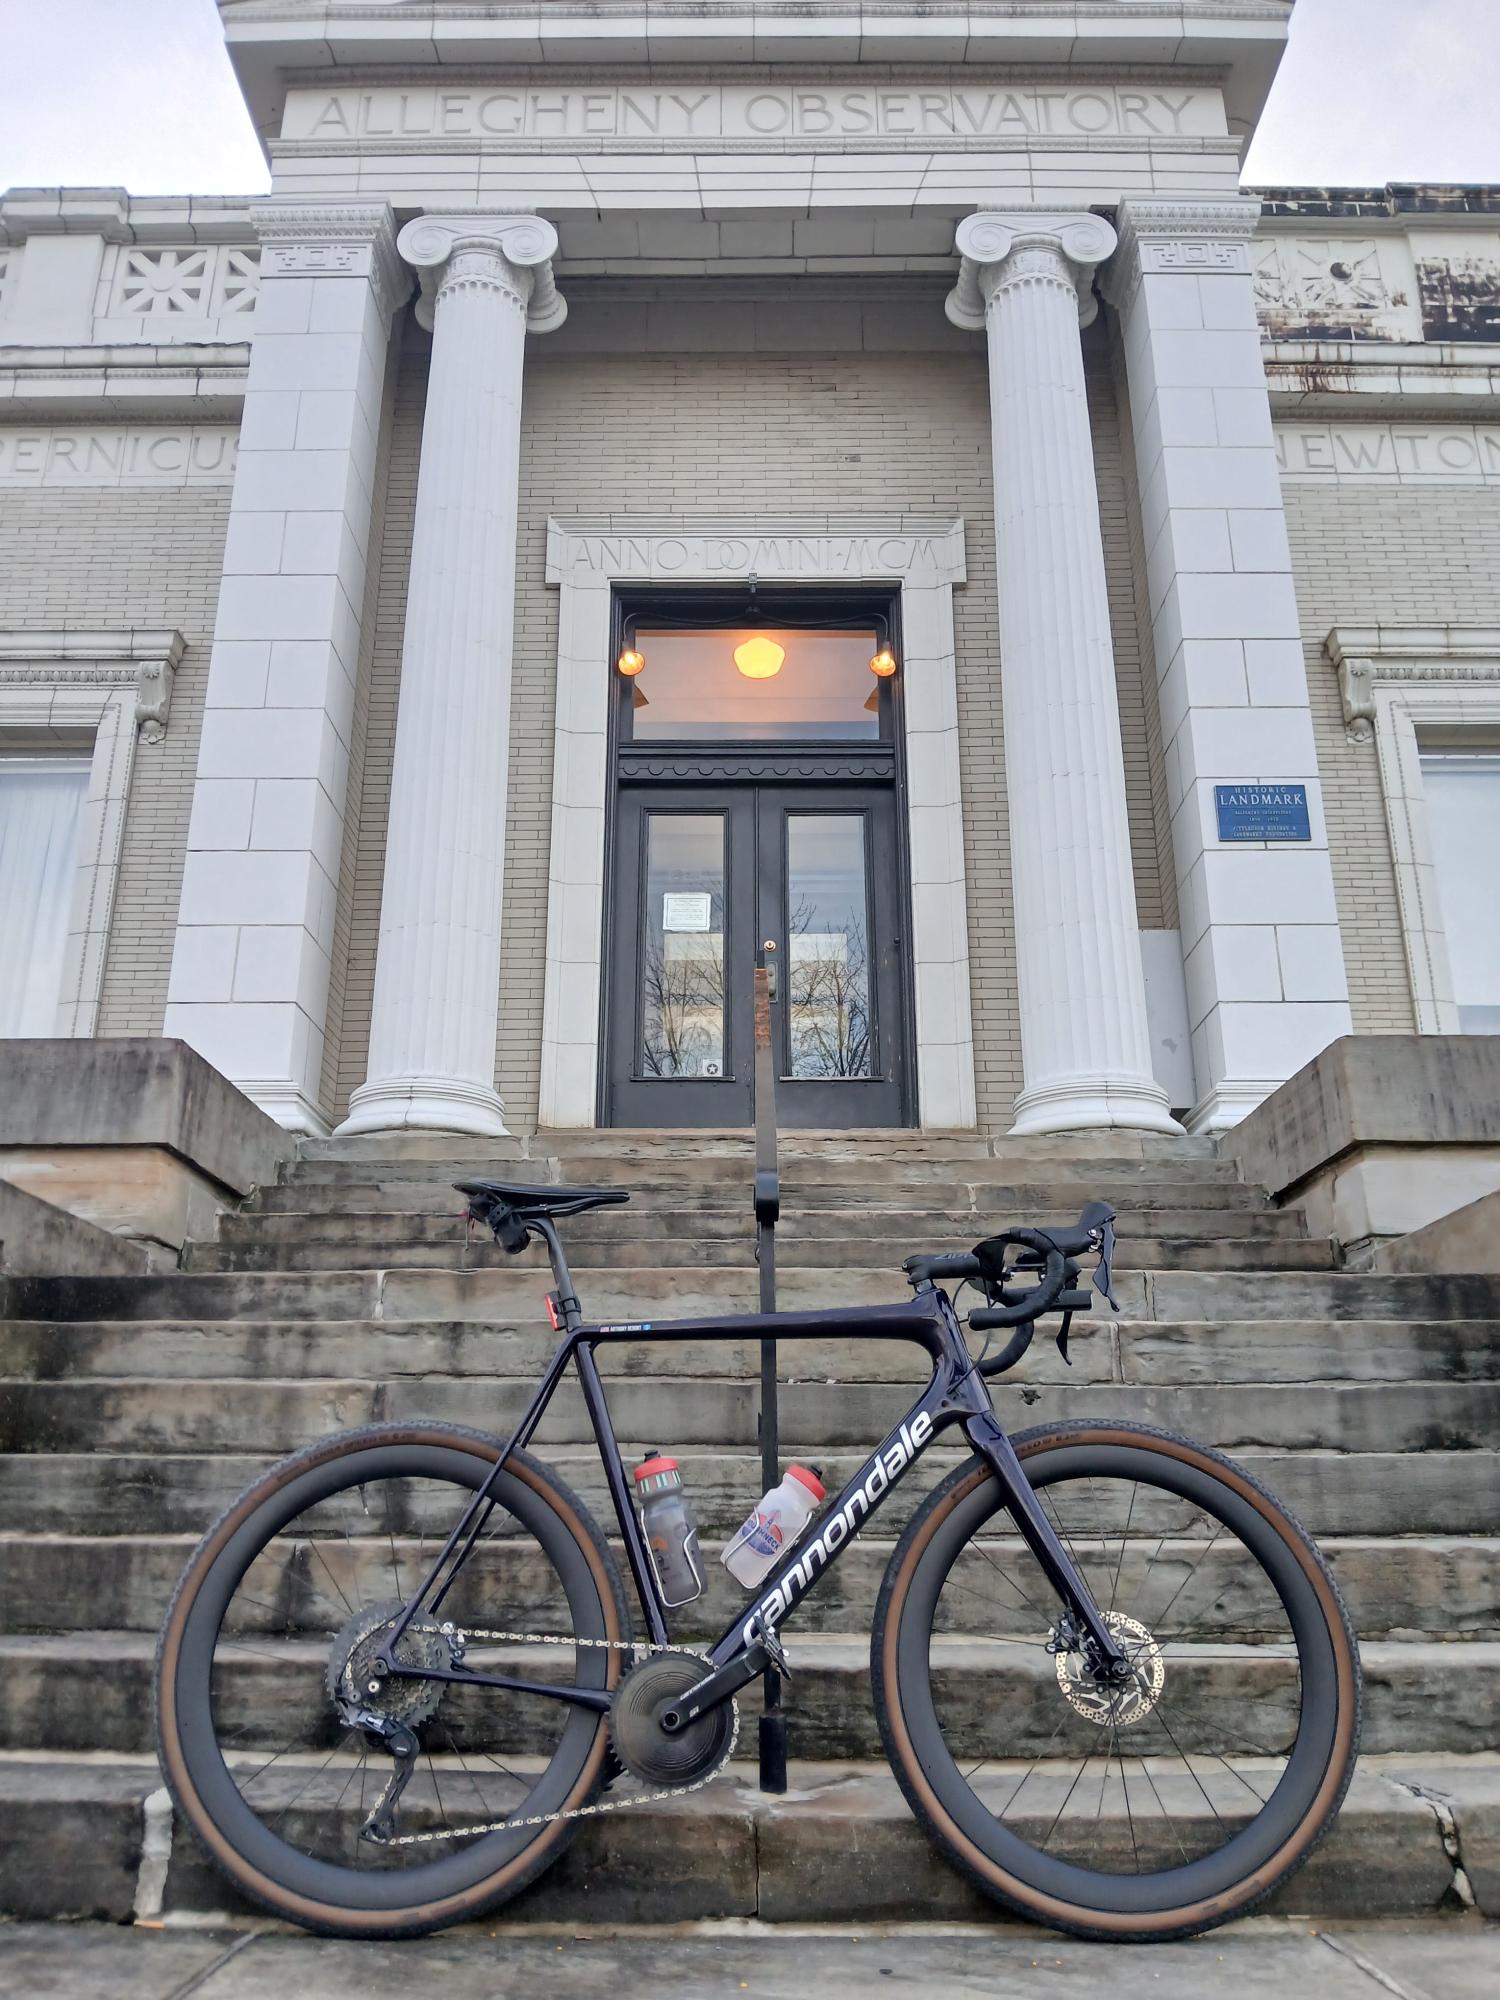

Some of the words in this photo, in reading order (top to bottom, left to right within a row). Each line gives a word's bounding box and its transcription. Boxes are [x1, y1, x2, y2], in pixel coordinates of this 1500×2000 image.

[308, 94, 711, 136] ALLEGHENY
[744, 93, 1195, 134] OBSERVATORY
[0, 436, 239, 473] ERNICU
[572, 538, 688, 570] ANNO
[702, 539, 833, 570] DOMINI
[842, 538, 939, 571] MCM
[1220, 793, 1303, 806] LANDMARK
[1234, 786, 1287, 794] HISTORIC
[743, 1410, 934, 1648] cannondale
